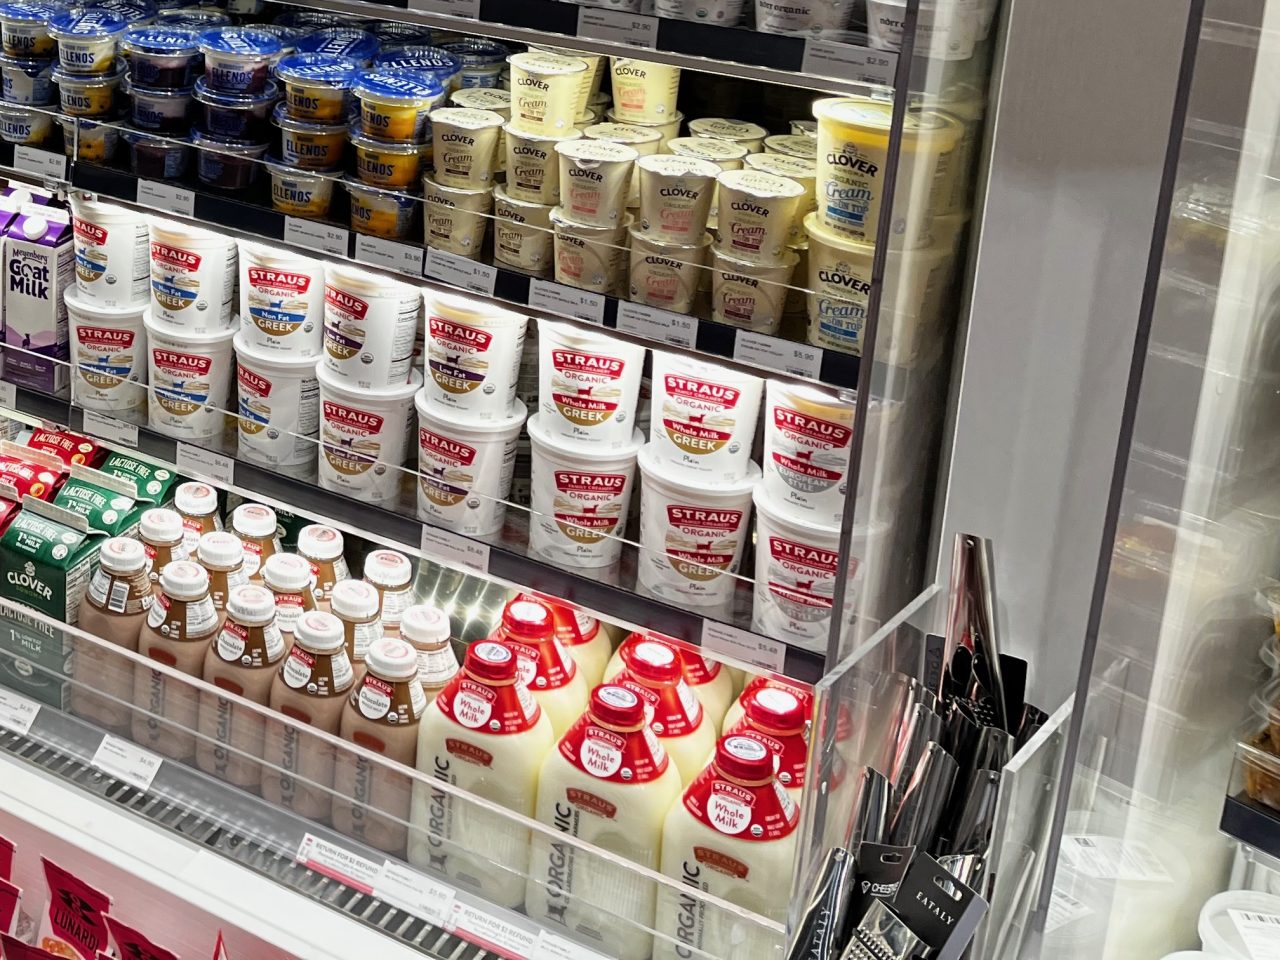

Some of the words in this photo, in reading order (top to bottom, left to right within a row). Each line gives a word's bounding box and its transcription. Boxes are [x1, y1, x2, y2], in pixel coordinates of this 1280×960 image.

[212, 69, 254, 83] ELLENOS
[518, 78, 550, 92] CLOVER
[441, 133, 475, 147] CLOVER
[443, 152, 473, 164] Cream
[514, 147, 547, 161] CLOVER
[827, 153, 879, 178] CLOVER
[569, 168, 603, 183] CLOVER
[273, 184, 312, 202] ELLENOS
[660, 188, 699, 201] CLOVER
[827, 181, 874, 200] Cream
[731, 201, 770, 218] CLOVER
[251, 269, 306, 287] STRAUS
[819, 270, 873, 295] CLOVER
[10, 275, 50, 301] Milk
[259, 286, 296, 298] ORGANIC
[819, 298, 868, 319] Cream
[258, 319, 293, 332] GREEK
[430, 320, 487, 343] STRAUS
[79, 328, 131, 342] STRAUS
[155, 351, 208, 369] STRAUS
[555, 352, 622, 372] STRAUS
[435, 373, 471, 392] GREEK
[565, 371, 608, 384] ORGANIC
[667, 376, 735, 401] STRAUS
[161, 398, 195, 412] GREEK
[563, 406, 604, 422] GREEK
[324, 402, 378, 427] STRAUS
[331, 422, 367, 438] ORGANIC
[776, 409, 846, 439] STRAUS
[421, 432, 470, 458] STRAUS
[673, 432, 717, 452] GREEK
[784, 430, 831, 451] ORGANIC
[328, 458, 363, 475] GREEK
[780, 456, 808, 474] Whole
[810, 466, 828, 479] Milk
[560, 474, 623, 489] STRAUS
[672, 508, 738, 525] STRAUS
[24, 538, 41, 550] MILK
[782, 560, 831, 580] ORGANIC
[7, 571, 53, 602] CLOVER
[226, 620, 248, 638] STRAUS
[789, 620, 807, 632] Plain
[21, 637, 43, 654] MILK
[360, 689, 389, 708] Chocolate
[461, 682, 495, 700] STRAUS
[460, 698, 485, 716] Whole
[460, 709, 480, 724] Milk
[588, 728, 624, 747] STRAUS
[587, 745, 615, 764] Whole
[587, 757, 610, 773] Milk
[714, 783, 753, 802] STRAUS
[715, 801, 744, 821] Whole
[715, 812, 739, 830] Milk
[316, 841, 337, 856] RETURN
[337, 851, 348, 861] FOR
[357, 860, 380, 875] REFUND
[916, 891, 955, 926] EATALY
[53, 907, 100, 954] LUNARDI
[464, 910, 487, 925] RETURN
[487, 919, 499, 929] FOR
[507, 927, 534, 946] REFUND
